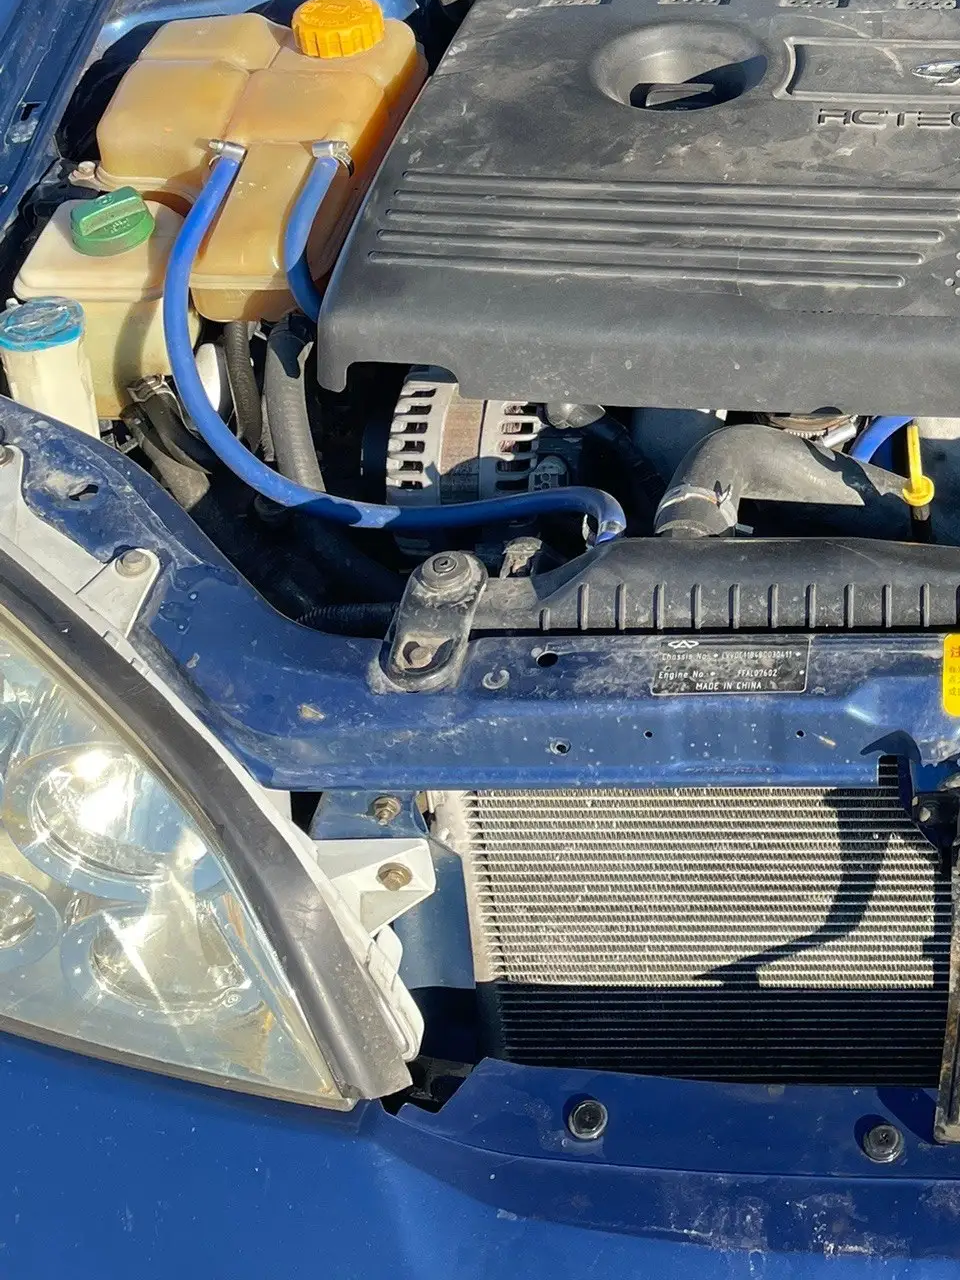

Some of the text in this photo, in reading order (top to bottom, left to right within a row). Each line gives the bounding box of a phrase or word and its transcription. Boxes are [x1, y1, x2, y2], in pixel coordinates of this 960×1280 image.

[658, 671, 689, 681] Engine
[695, 681, 762, 691] MADE IN CHINA
